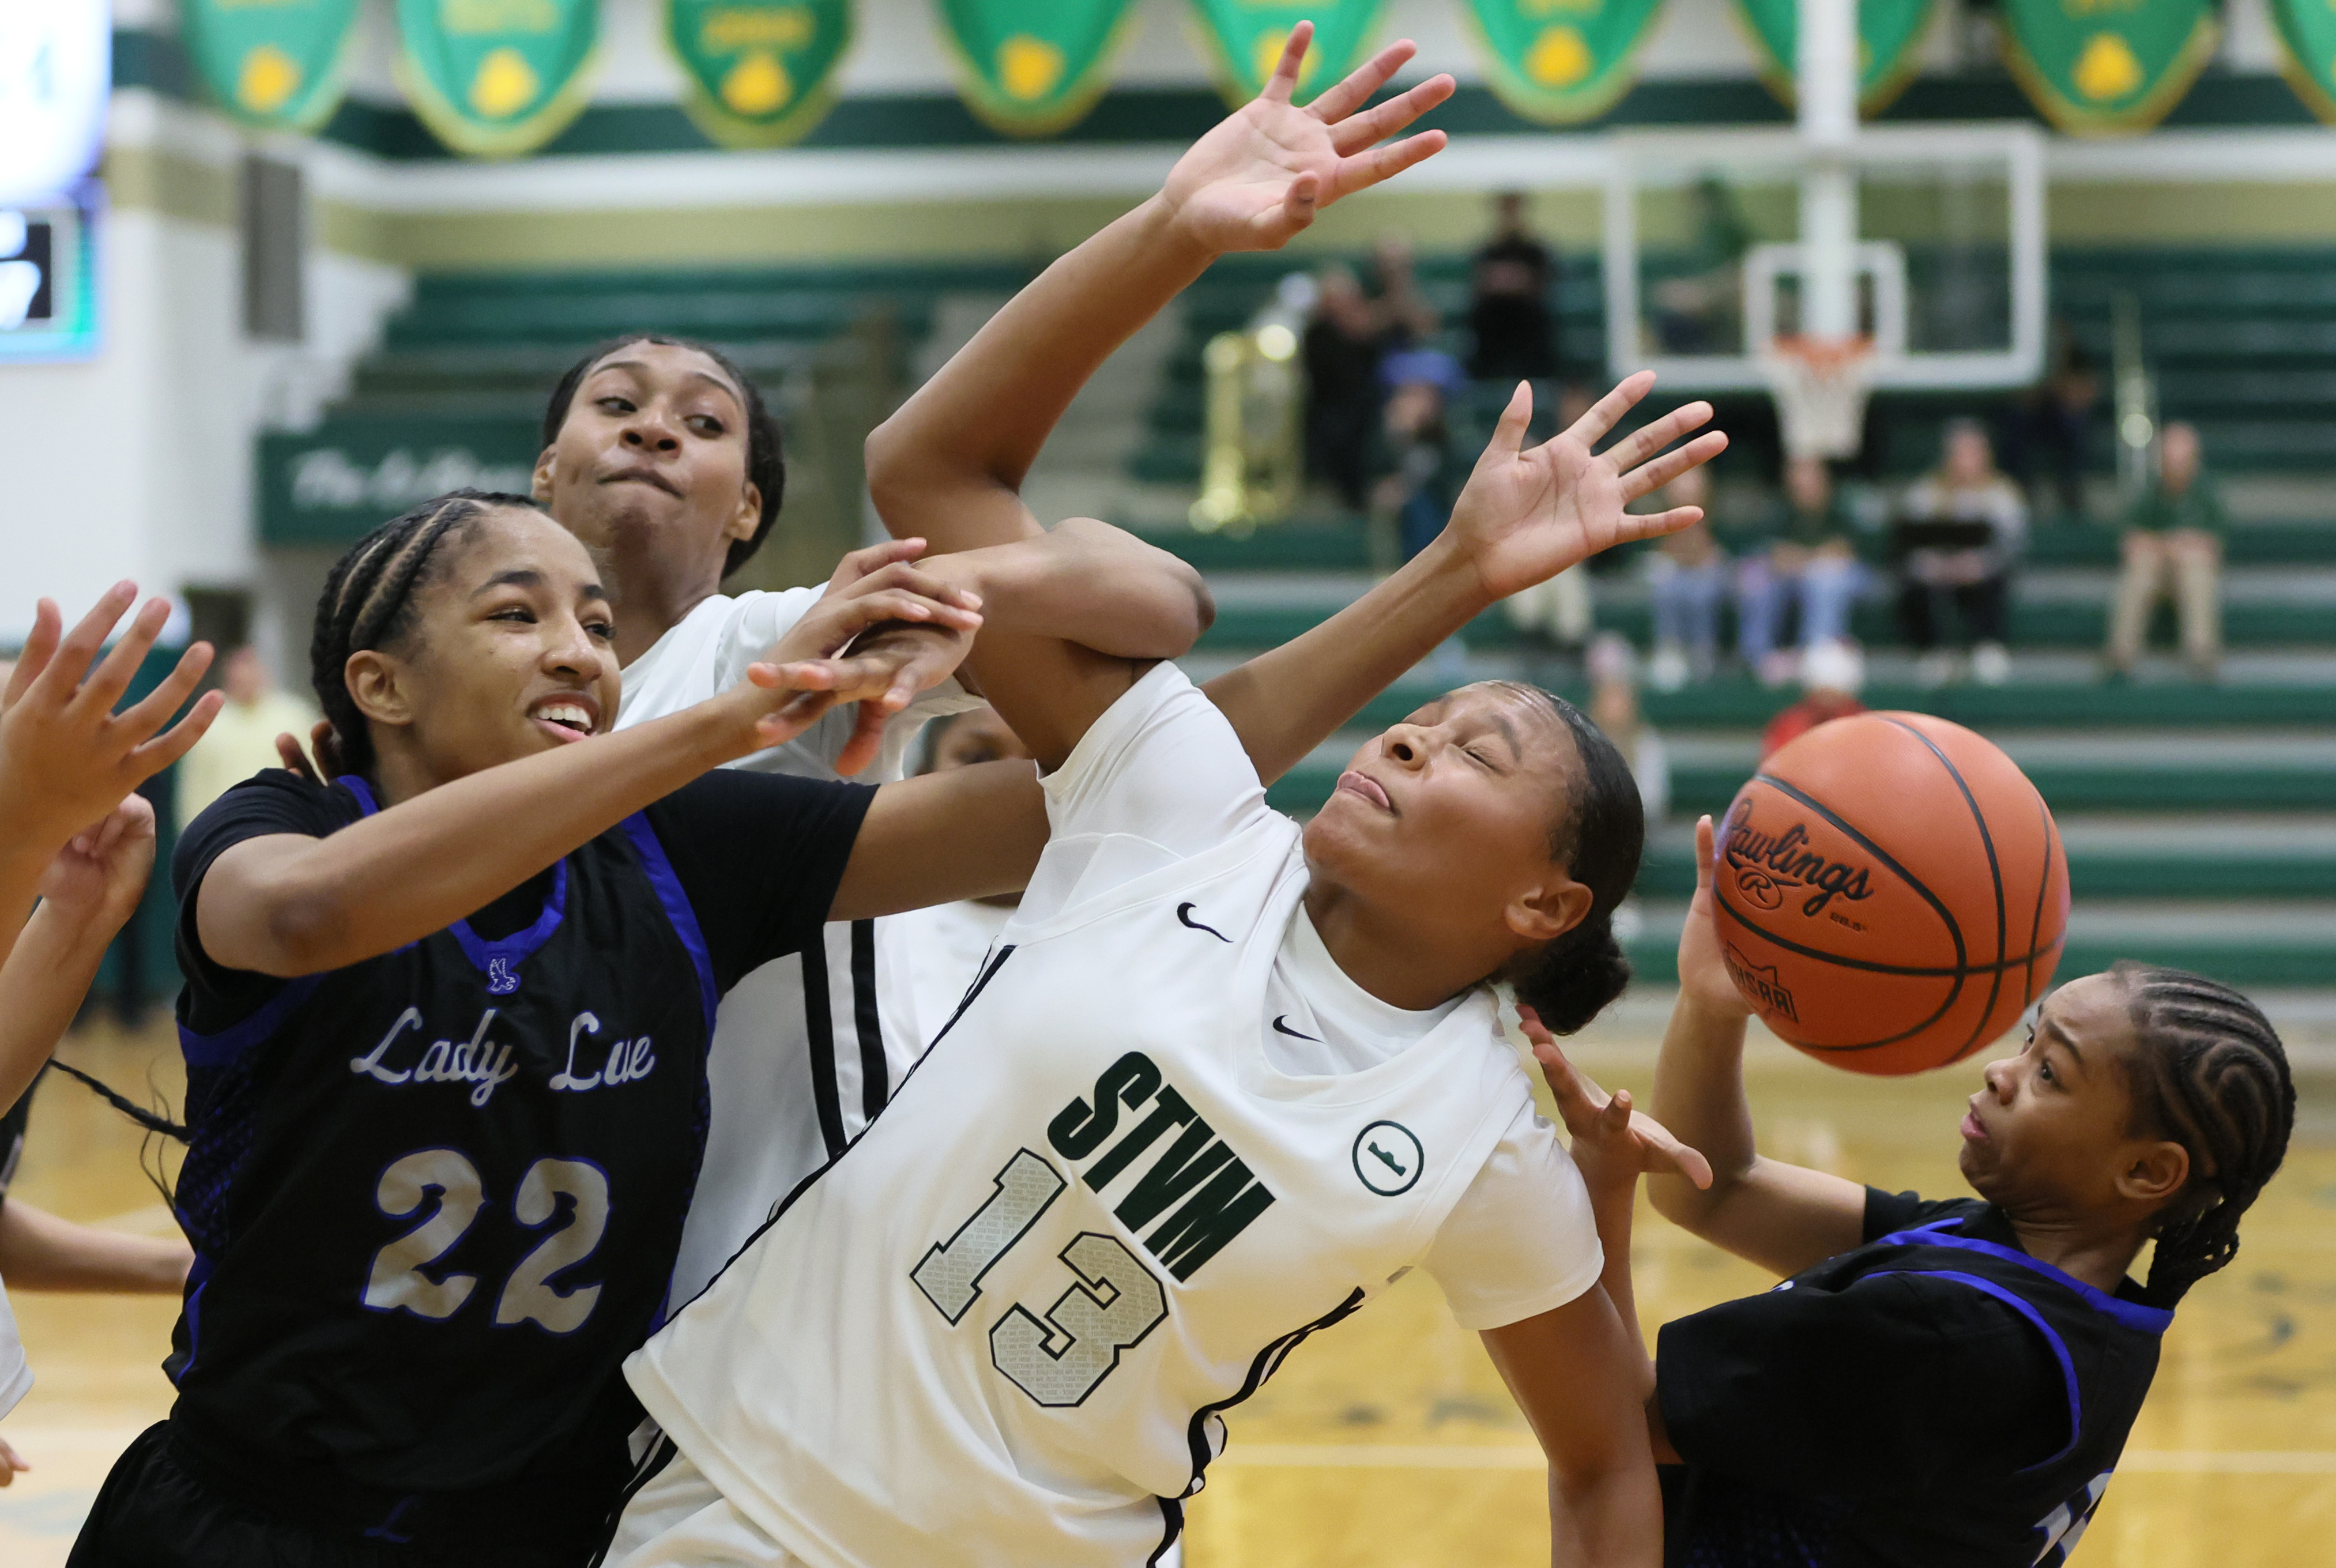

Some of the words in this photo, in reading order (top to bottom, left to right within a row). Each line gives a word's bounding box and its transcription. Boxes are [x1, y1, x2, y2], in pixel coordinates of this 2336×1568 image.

[349, 1005, 519, 1107] Lady
[1724, 948, 1791, 1013] HSAA
[361, 1145, 613, 1335] 22
[1047, 1051, 1276, 1284] STVM
[909, 1147, 1169, 1407] 13
